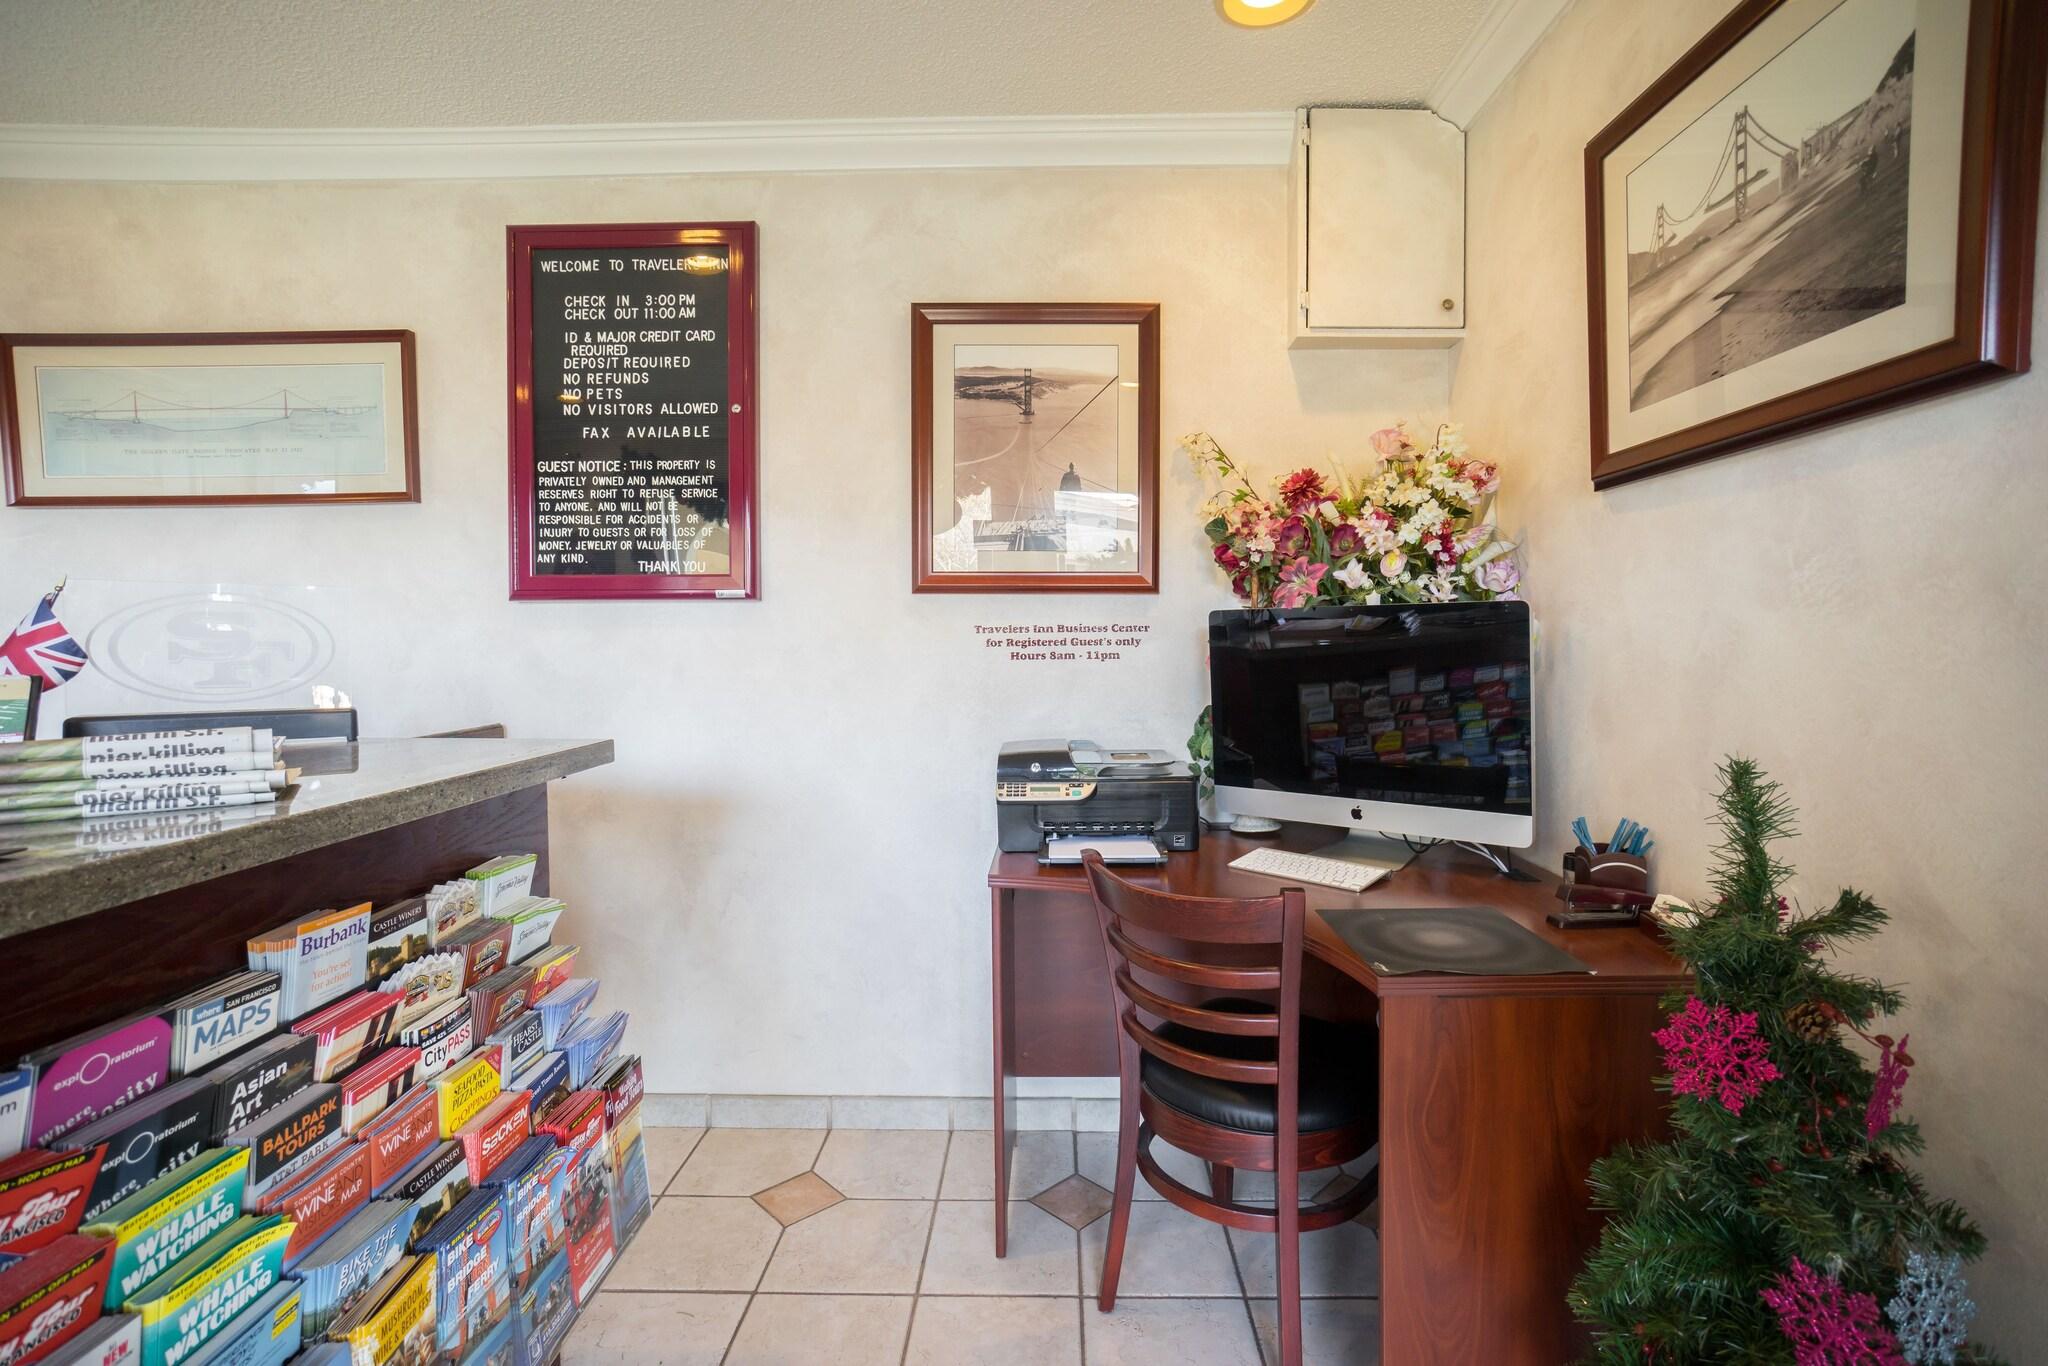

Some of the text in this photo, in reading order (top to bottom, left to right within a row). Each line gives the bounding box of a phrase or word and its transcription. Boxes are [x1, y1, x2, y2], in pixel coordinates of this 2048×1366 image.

[540, 259, 600, 273] WELCOME
[609, 259, 624, 272] TO
[564, 294, 696, 308] CHECK IN 3:00 PM
[564, 307, 696, 320] CHECK OUT 11:00 AM
[564, 330, 716, 343] ID & MAJOR CREDIT CARD
[563, 357, 691, 369] DEPOSIT REQUIRED
[571, 344, 628, 356] REQUIRED
[563, 373, 649, 385] NO REFUNDS
[563, 388, 623, 400] NO PETS
[563, 402, 718, 416] NO VISITORS ALLOWED
[582, 426, 710, 439] FAX AVAILABLE
[537, 461, 575, 473] GUEST
[629, 460, 653, 471] THIS
[656, 460, 700, 470] PROPERTY
[706, 460, 716, 469] IS
[538, 475, 714, 487] PRIVATELY OWNED AND MANAGEMENT
[538, 489, 718, 500] RESERVES RIGHT TO REFUSE SERVICE
[539, 502, 550, 512] TO
[598, 502, 616, 512] AND
[620, 502, 642, 512] WILL
[646, 501, 663, 511] NOT
[668, 501, 679, 511] BE
[539, 514, 699, 525] RESPONSIBLE FOR ACCIDENTS OR
[539, 526, 713, 538] INJURY TO GUESTS OR FOR LOSS OF
[575, 540, 618, 550] JEWELRY
[620, 540, 633, 550] OR
[636, 540, 689, 550] VALUABLES
[693, 540, 705, 549] OF
[537, 553, 588, 564] ANY KIND.
[638, 560, 706, 572] THANK YOU
[974, 623, 1150, 634] Travelers Inn Business Center
[986, 637, 1142, 649] for Registered Guest's only
[1010, 651, 1046, 661] Hours
[1050, 651, 1076, 660] 8am
[1086, 651, 1120, 662] 11pm
[143, 783, 221, 800] killing
[89, 799, 148, 813] man
[373, 915, 398, 934] CASTLE
[397, 905, 423, 923] WINERY
[300, 918, 367, 957] Burbank
[196, 983, 277, 1020] where SAN FRANCISCO
[193, 998, 273, 1054] MAPS
[512, 1020, 539, 1047] HEARST
[424, 1024, 471, 1067] CityPASS
[517, 1026, 543, 1053] CASTLE
[231, 1061, 288, 1105] Asian
[454, 1064, 486, 1095] SEAFOOD
[229, 1090, 263, 1127] Art
[262, 1096, 338, 1157] BALLPARK
[415, 1121, 433, 1143] MAP
[276, 1120, 326, 1161] TOURS
[301, 1140, 329, 1166] PARK
[380, 1124, 412, 1158] WINE
[42, 1164, 63, 1177] OFF
[63, 1155, 86, 1168] MAP
[339, 1154, 365, 1177] COUNTRY
[409, 1168, 435, 1194] CASTLE
[435, 1147, 461, 1171] WINERY
[340, 1178, 363, 1204] MAP
[517, 1174, 539, 1201] BIKE
[12, 1188, 81, 1231] Tour
[295, 1183, 336, 1222] WINE
[516, 1184, 549, 1226] BRIDGE
[530, 1196, 557, 1231] FERRY
[135, 1187, 227, 1265] WHALE
[121, 1202, 234, 1296] WATCHING
[340, 1223, 398, 1281] BIKE THE
[447, 1232, 474, 1267] BIKE
[447, 1244, 488, 1294] BRIDGE
[467, 1256, 500, 1299] FERRY
[179, 1254, 266, 1335] WHALE
[164, 1269, 273, 1366] WATCHING
[380, 1283, 424, 1339] MUSHROOM
[372, 1335, 394, 1365] WINE
[394, 1331, 400, 1343] &
[401, 1312, 417, 1335] BEER
